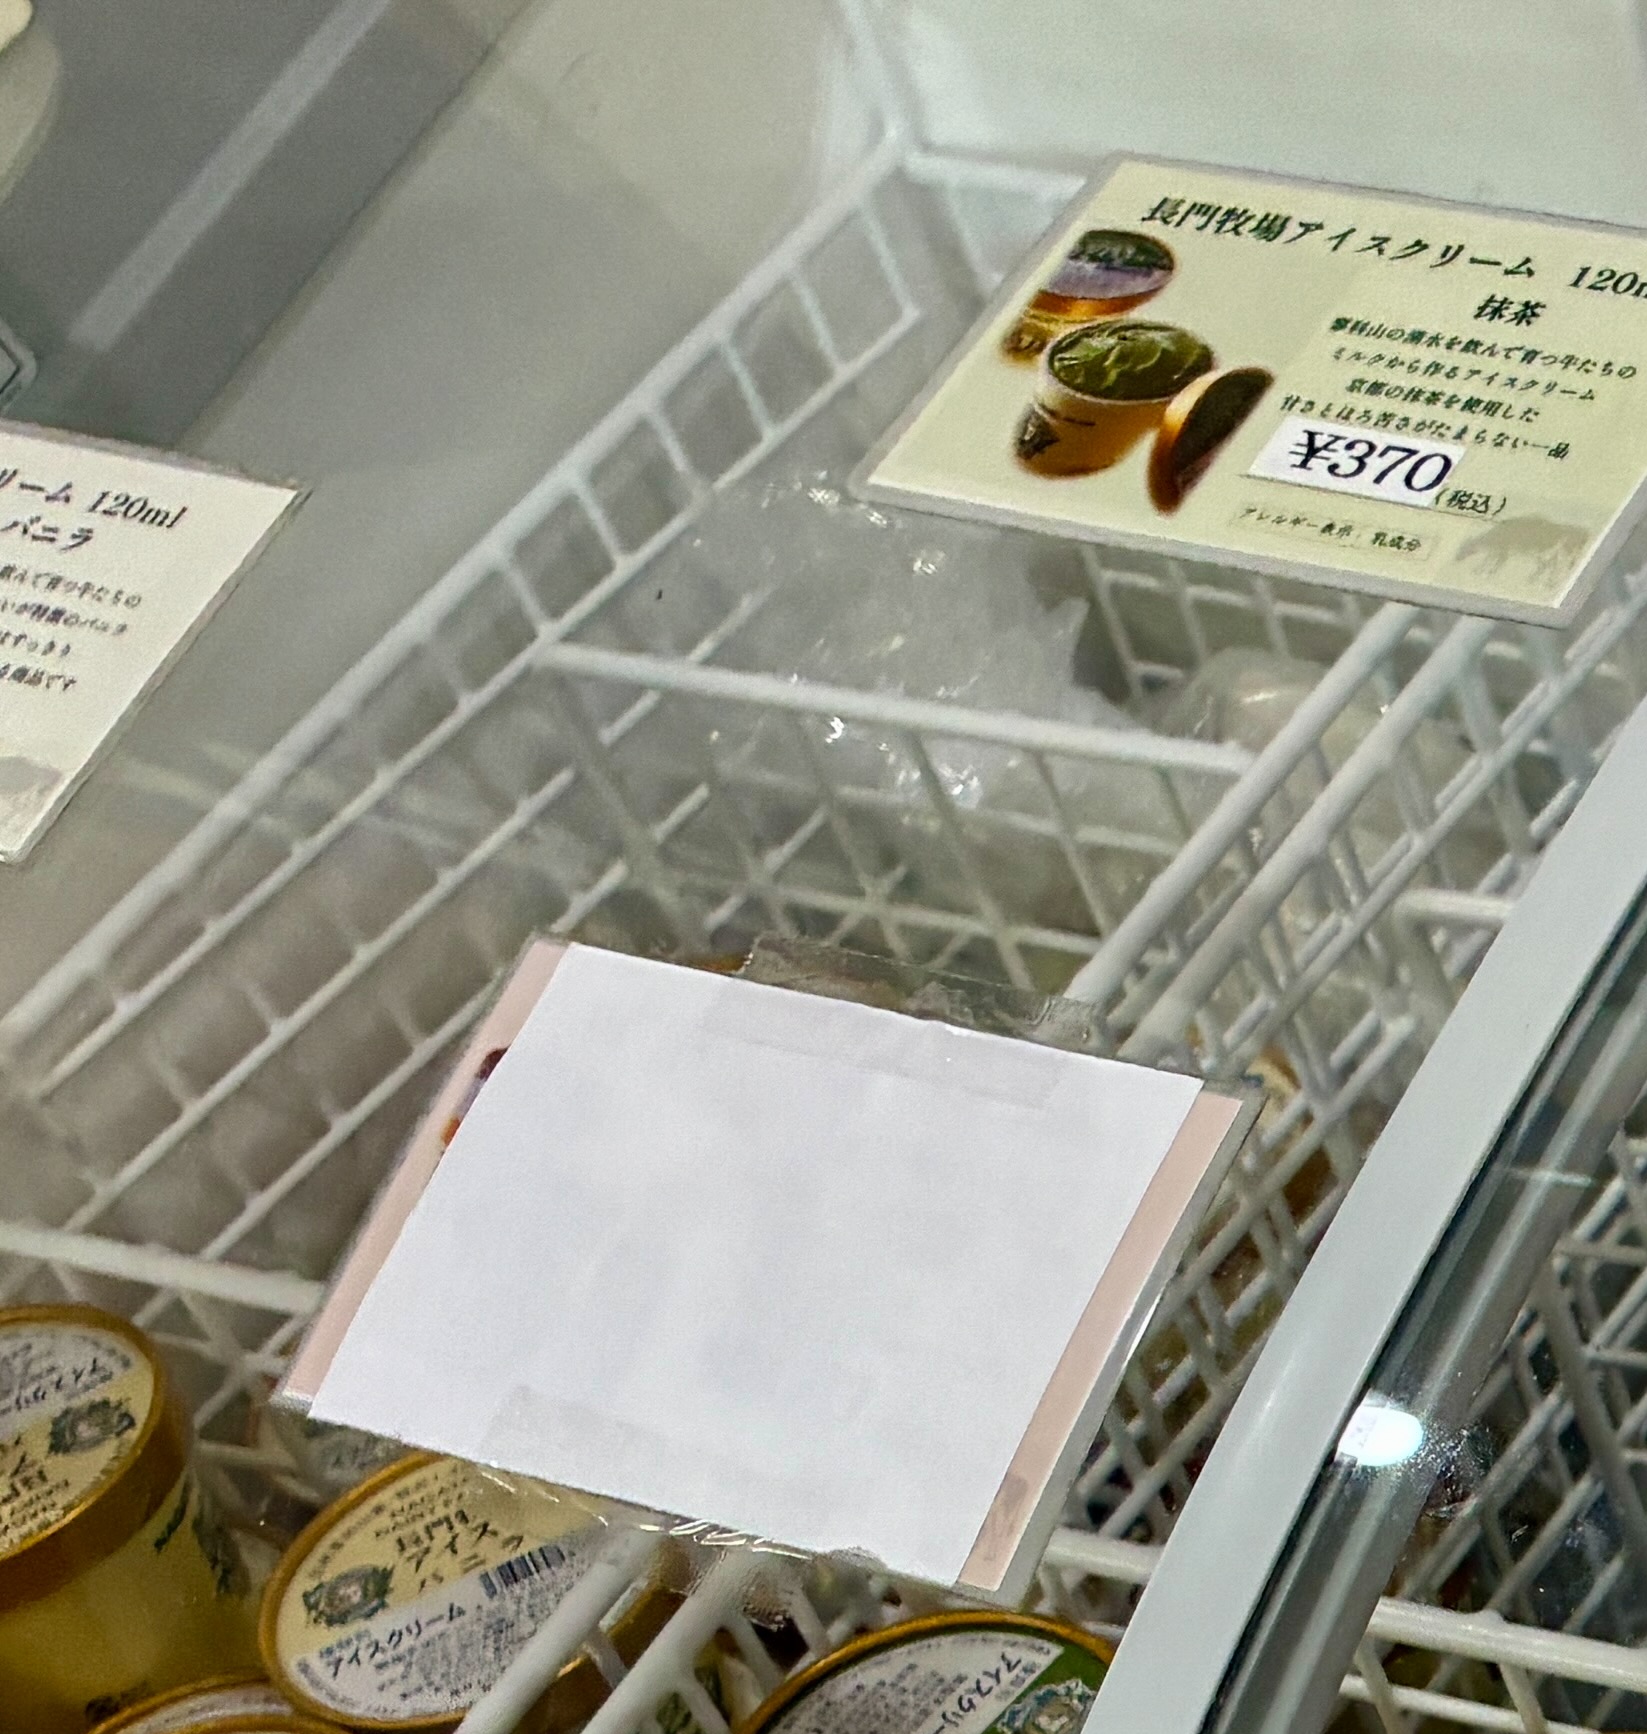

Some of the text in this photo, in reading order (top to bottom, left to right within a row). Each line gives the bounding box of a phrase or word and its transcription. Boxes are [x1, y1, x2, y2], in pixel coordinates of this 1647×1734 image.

[1141, 198, 1536, 279] 長門牧場アイスクリーム
[1474, 295, 1548, 326] 抹茶
[1332, 349, 1596, 400] ミルクから作るアイスクリーム
[1289, 430, 1453, 492] ¥370
[88, 490, 188, 529] 120ml
